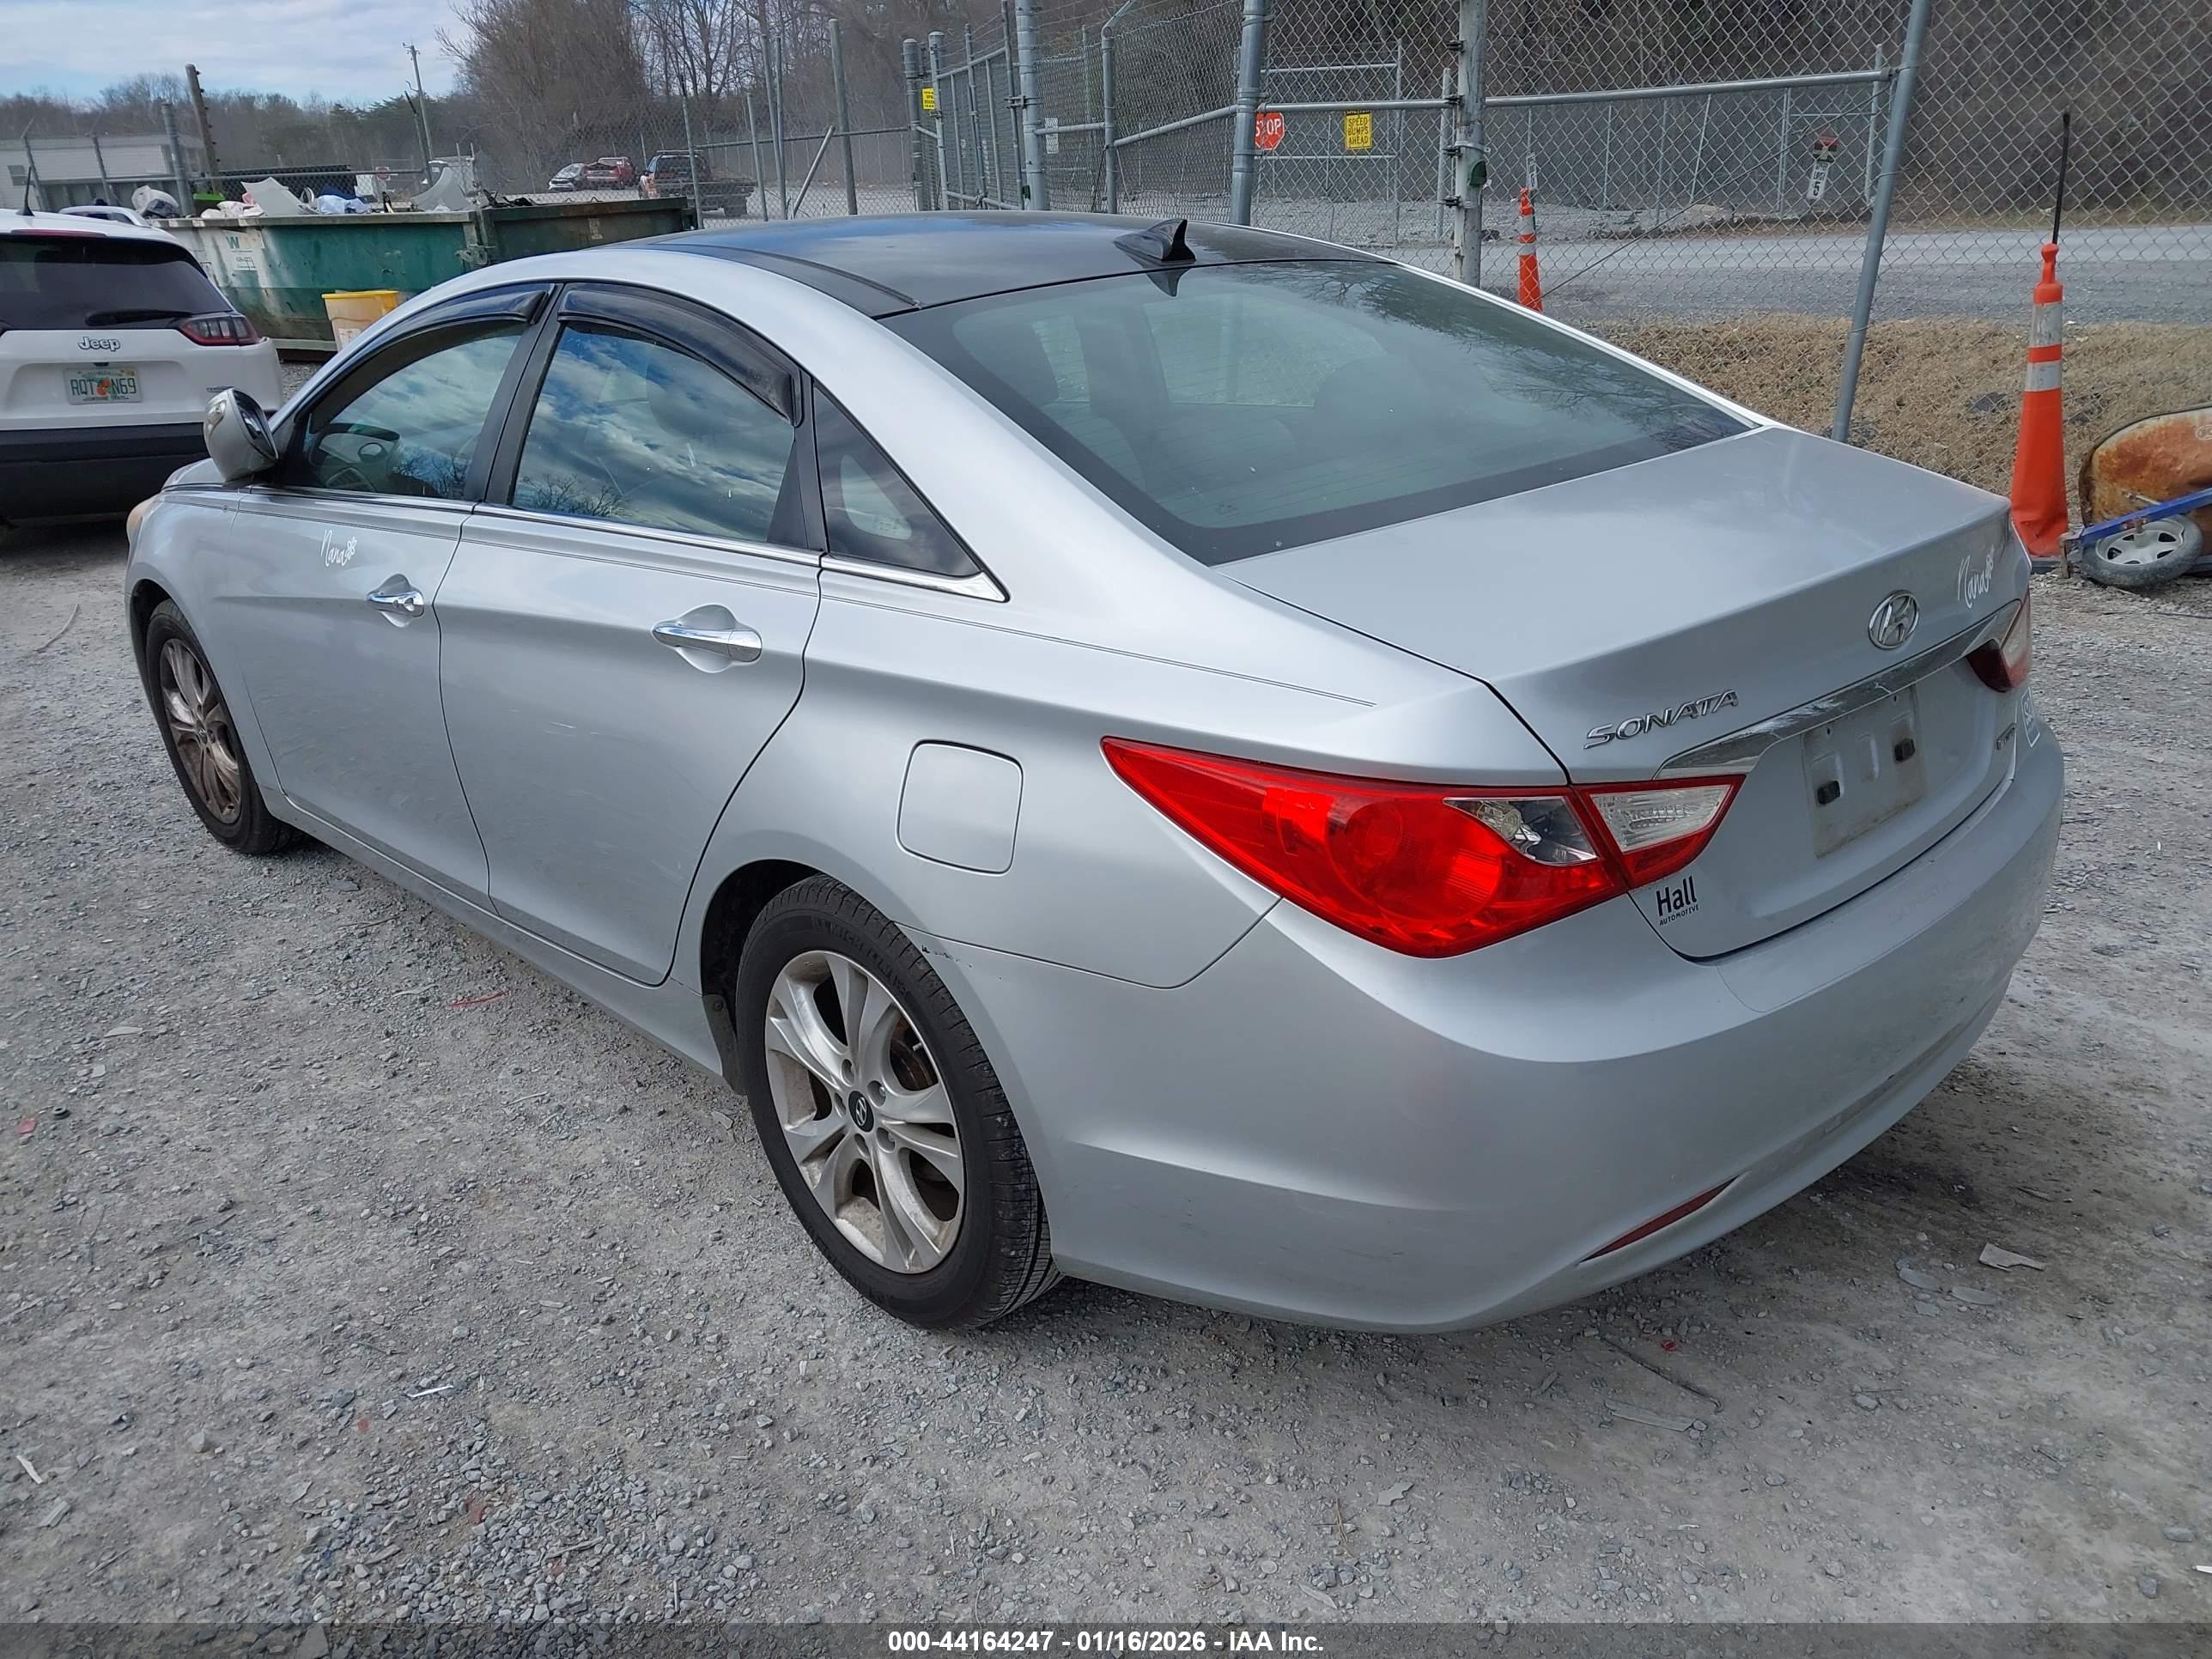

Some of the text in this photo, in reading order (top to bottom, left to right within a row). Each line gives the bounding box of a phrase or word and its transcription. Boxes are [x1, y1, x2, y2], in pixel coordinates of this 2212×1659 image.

[1348, 117, 1368, 126] SPEED
[1347, 126, 1369, 136] BUMPS
[1348, 136, 1369, 144] AHEAD
[78, 337, 121, 351] Jeep
[1583, 689, 1739, 750] SONATA
[1656, 875, 1697, 917] Hall
[1659, 904, 1698, 927] AUTOMOTIVE
